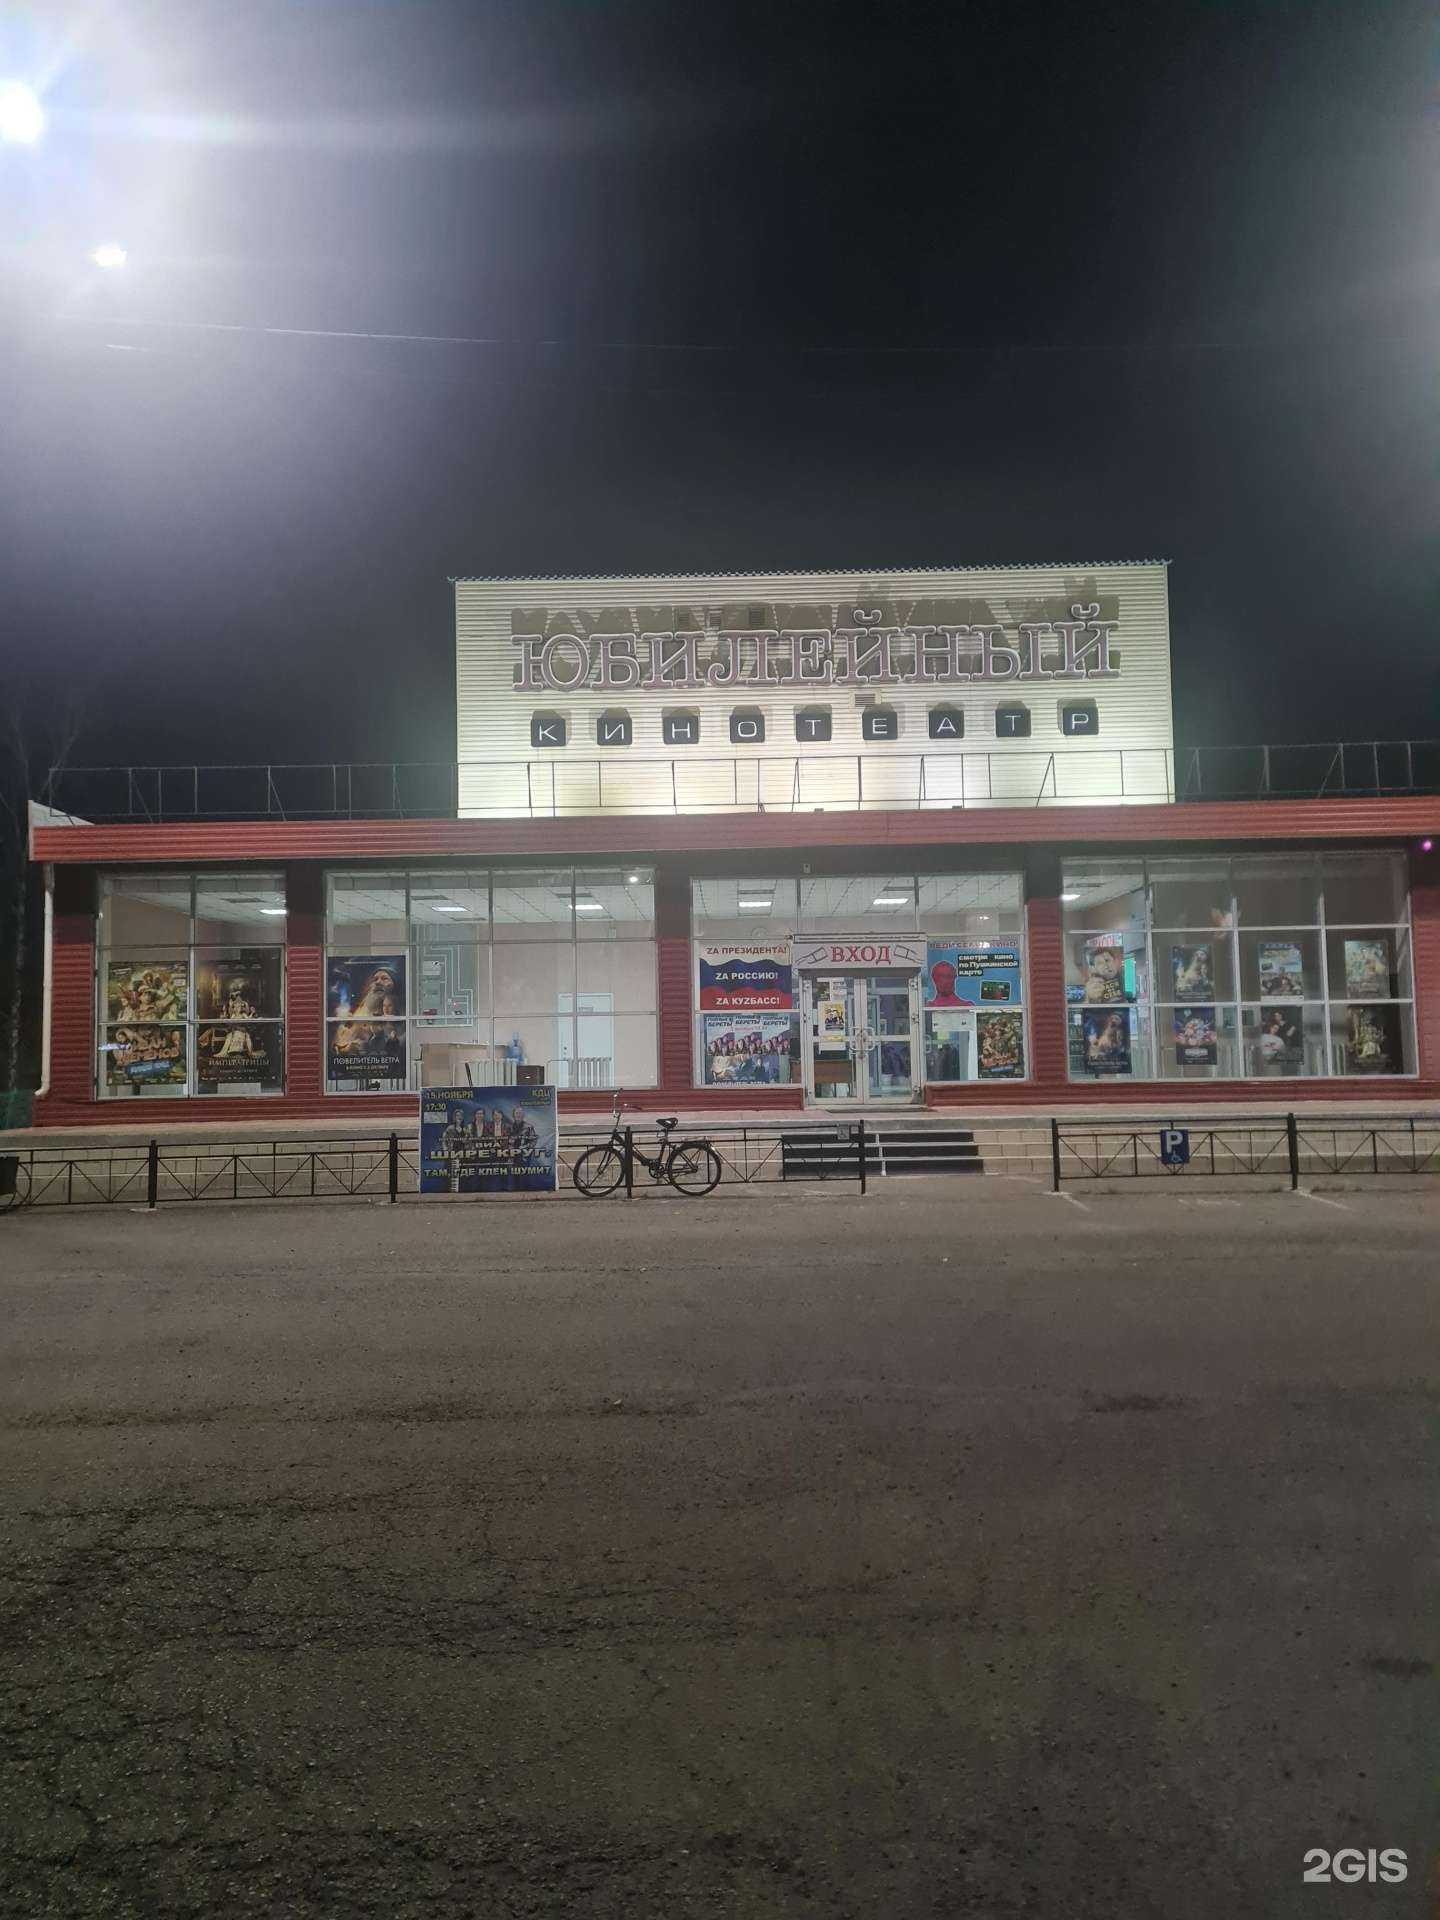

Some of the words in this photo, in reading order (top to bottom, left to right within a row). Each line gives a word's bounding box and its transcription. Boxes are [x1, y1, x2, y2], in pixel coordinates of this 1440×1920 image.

[511, 603, 1120, 691] ЮБИЛЕЙНЫЙ
[538, 712, 1089, 741] КИНОТЕАТР
[706, 947, 719, 955] ZA
[722, 946, 787, 955] ПРЕЗИДЕНТА!
[831, 945, 891, 965] ВХОД
[715, 972, 728, 980] ZA
[731, 972, 778, 980] РОССИЮ!
[716, 997, 729, 1005] ZA
[732, 997, 779, 1005] КУZБАСС!
[333, 1056, 379, 1065] ПОВЕЛИТЕЛЬ
[381, 1056, 400, 1064] ВЕТРА
[1166, 1131, 1183, 1153] P
[430, 1149, 490, 1159] ШИРЕ
[511, 1166, 551, 1175] ШУМИТ
